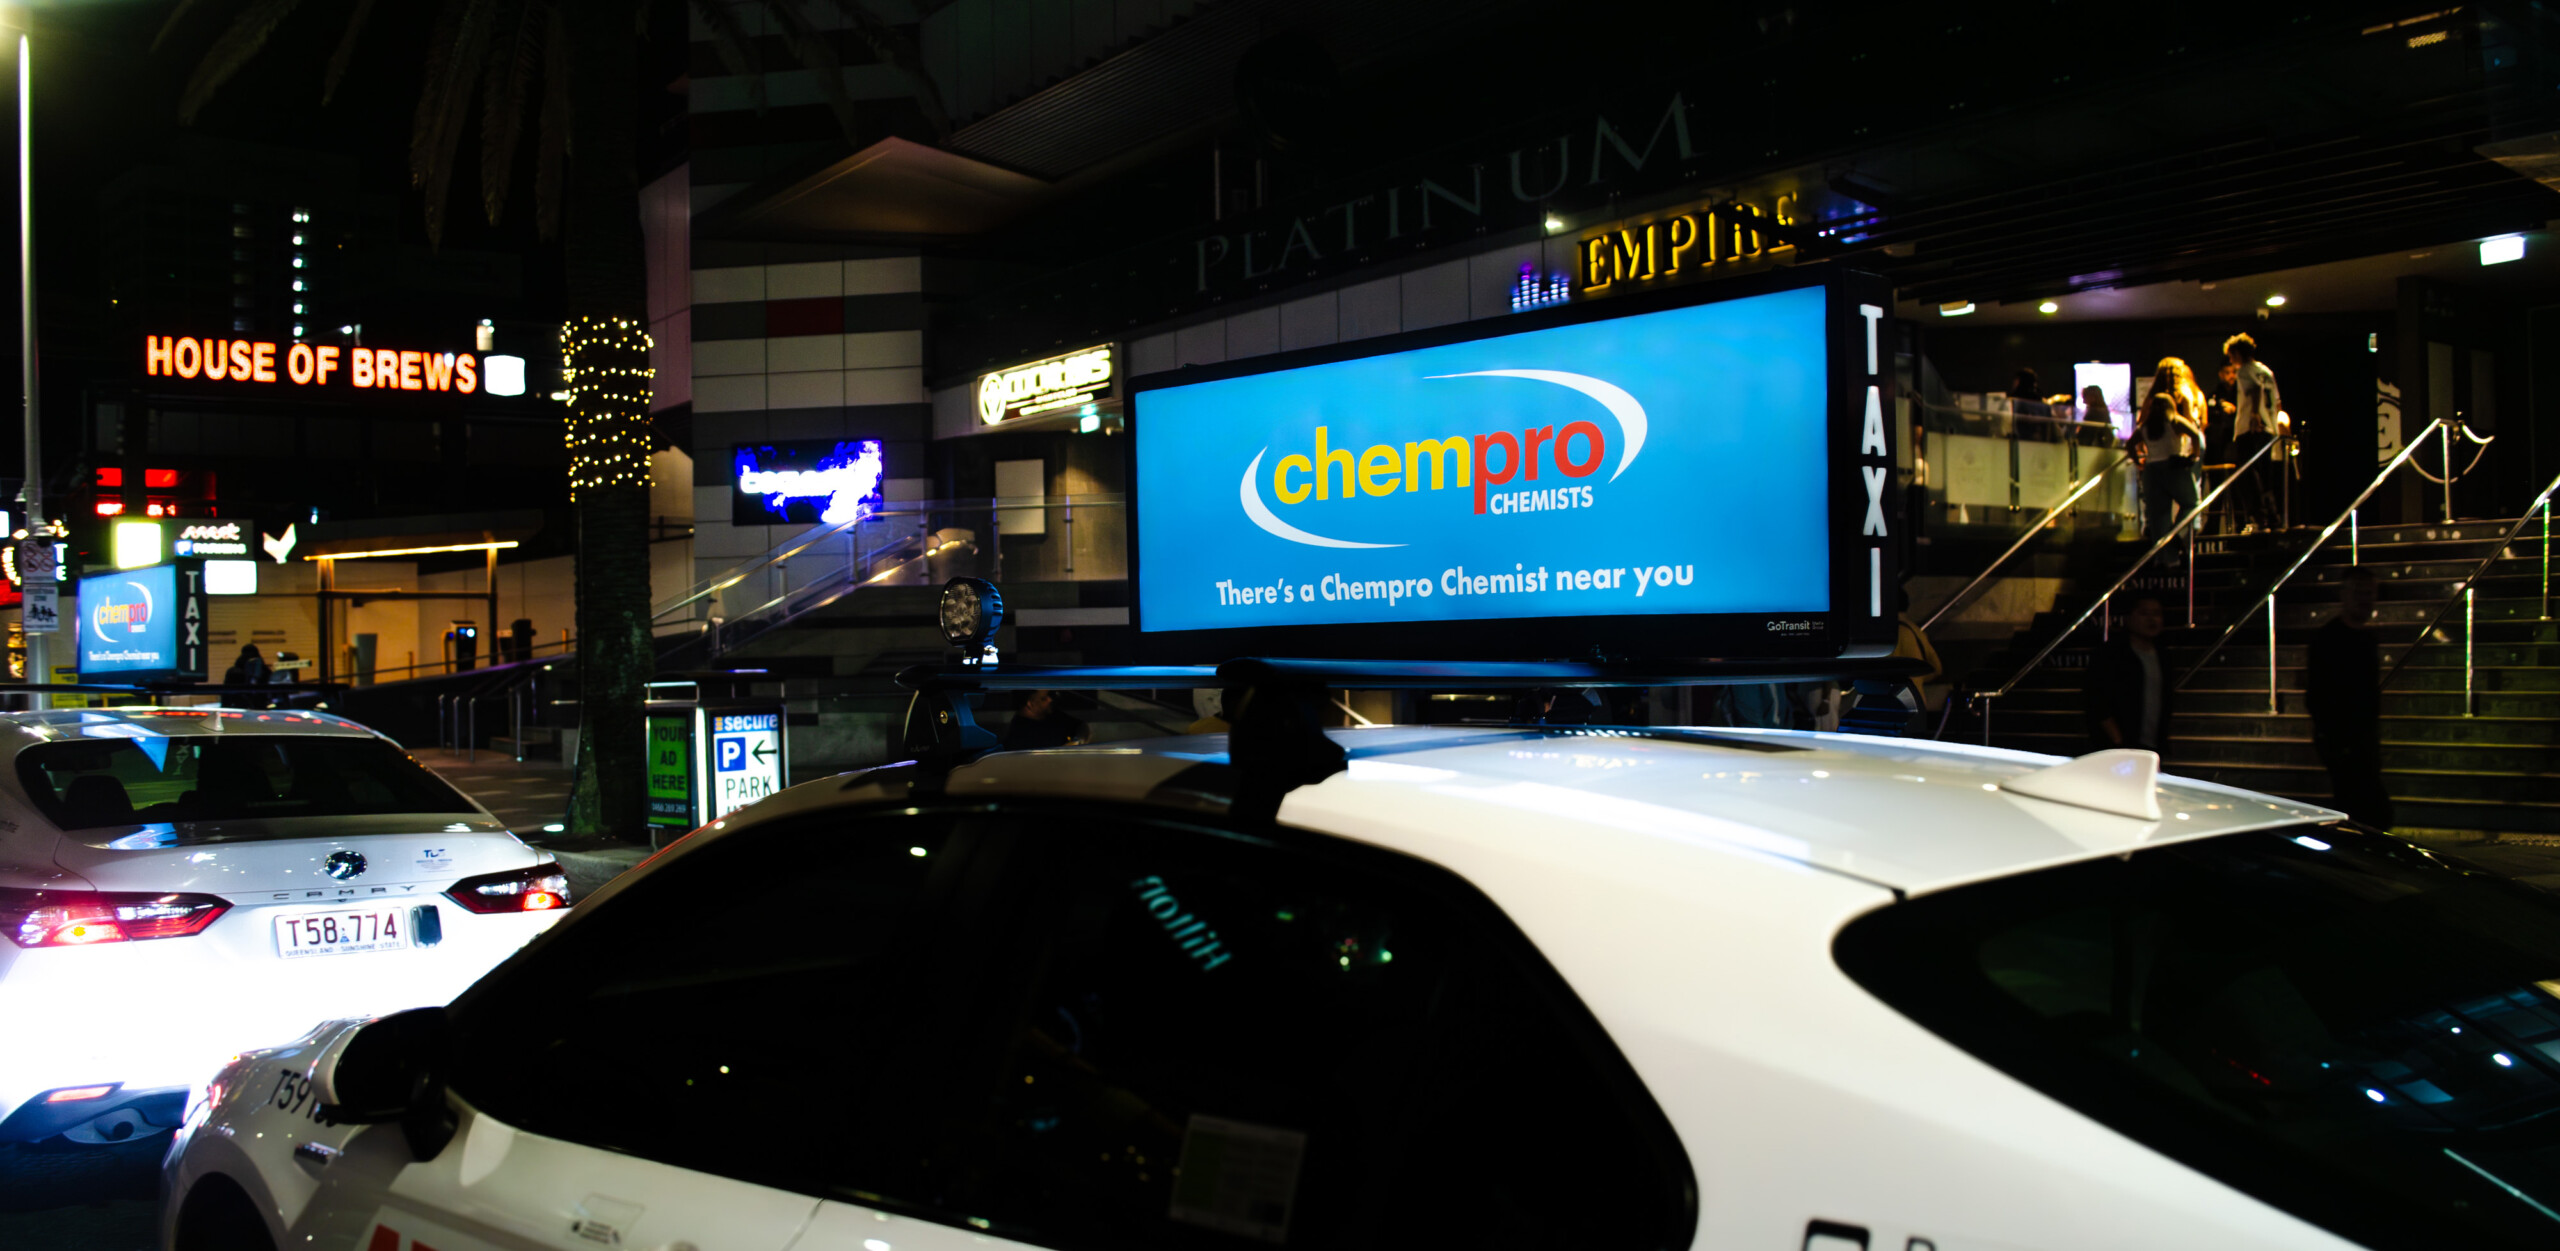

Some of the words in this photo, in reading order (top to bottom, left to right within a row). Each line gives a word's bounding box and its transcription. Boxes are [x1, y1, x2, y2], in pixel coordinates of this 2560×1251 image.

[1192, 90, 1704, 294] PLATINUM
[147, 335, 276, 382] HOUSE
[287, 343, 340, 384] OF
[352, 347, 477, 393] BREWS
[1273, 420, 1605, 515] chempro
[1860, 303, 1888, 617] TAXI
[1490, 485, 1593, 515] CHEMISTS
[1215, 578, 1295, 606] There's
[1300, 584, 1315, 603] a
[1320, 572, 1434, 606] Chempro
[1441, 563, 1549, 597] Chemist
[1556, 565, 1627, 592] near
[1632, 564, 1695, 597] you
[99, 596, 147, 632] chempro
[185, 571, 200, 671] TAXI
[1766, 620, 1810, 631] GoTransit
[653, 726, 685, 741] YOUR
[724, 714, 779, 732] secure
[660, 750, 677, 766] AD
[722, 741, 741, 769] P
[652, 774, 685, 790] HERE
[725, 775, 773, 799] PARK
[273, 884, 416, 899] CAMRY
[286, 916, 339, 947] T58
[348, 913, 397, 941] 774
